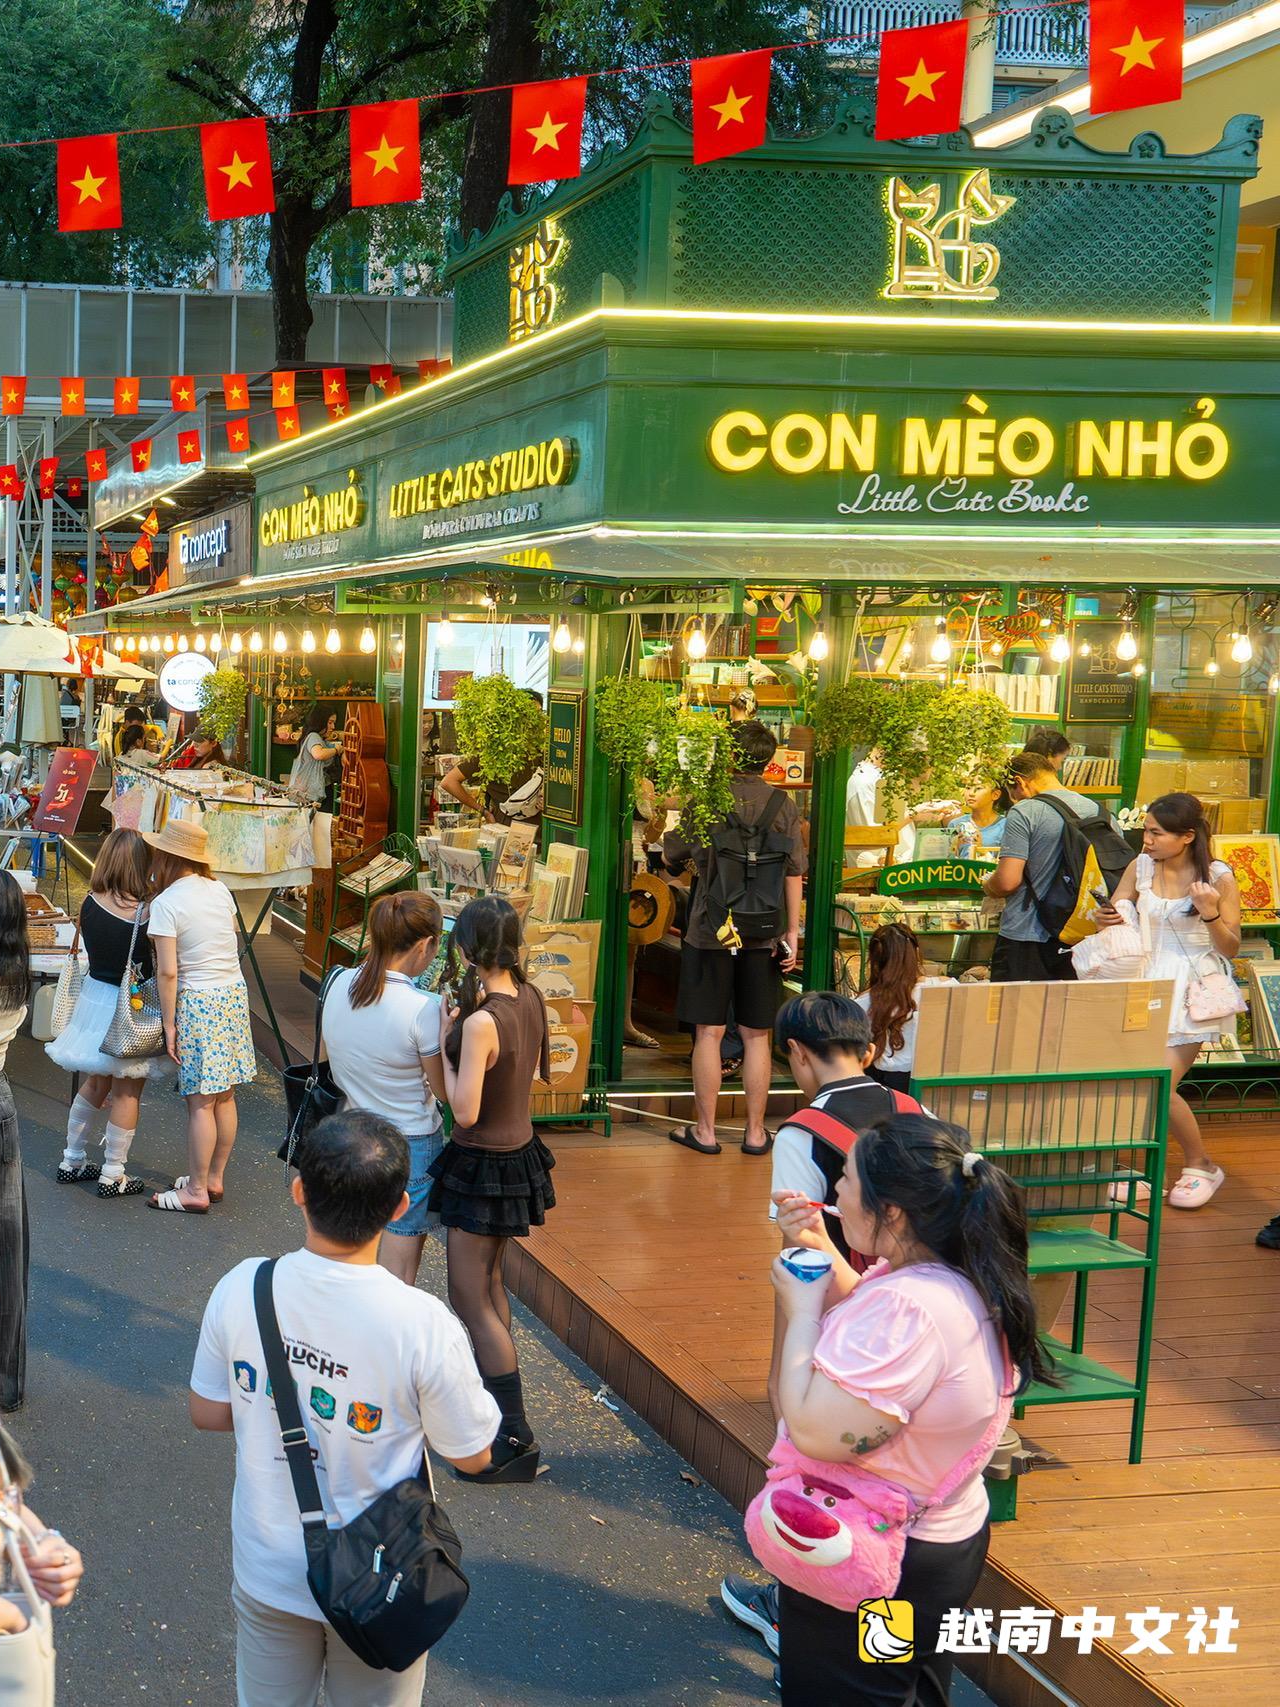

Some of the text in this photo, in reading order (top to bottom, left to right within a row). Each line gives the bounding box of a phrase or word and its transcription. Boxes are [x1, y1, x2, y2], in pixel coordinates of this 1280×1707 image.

[710, 394, 1229, 480] CON MÈO NHỎ
[390, 437, 565, 519] LITTLE CATS STUDIO
[837, 475, 1090, 514] Little Cats Books
[261, 469, 358, 547] CON MÈO NHỎ
[503, 502, 540, 527] CRAFTS
[179, 533, 188, 565] ta
[189, 520, 228, 567] concept
[1074, 683, 1132, 694] LITTLE CATS STUDIO
[553, 727, 571, 744] HELLO
[54, 783, 69, 802] 51
[886, 867, 924, 888] CON
[927, 861, 965, 883] MÈO
